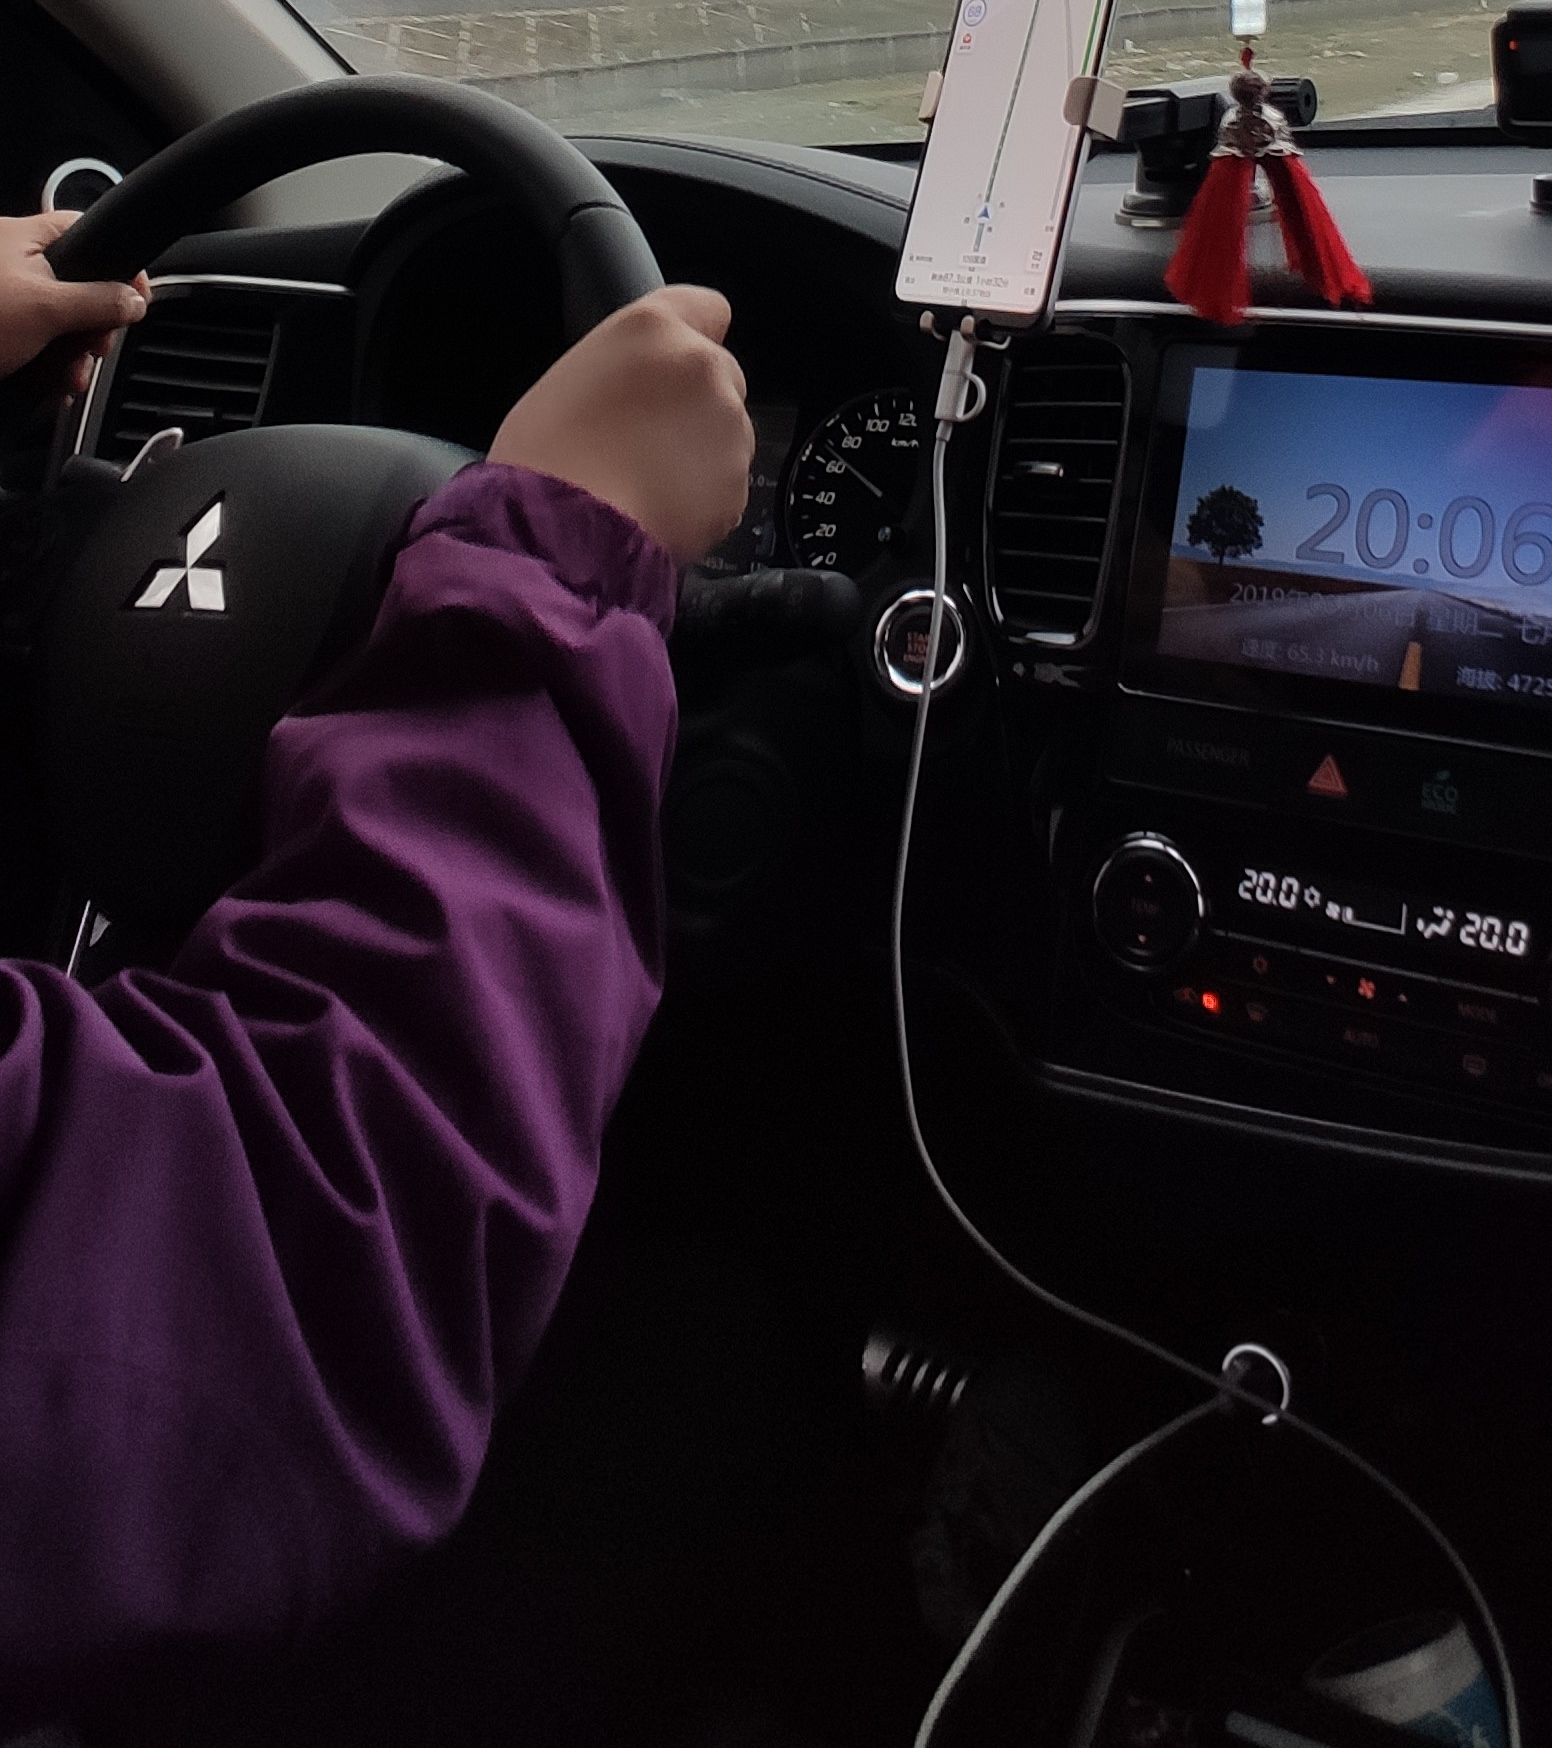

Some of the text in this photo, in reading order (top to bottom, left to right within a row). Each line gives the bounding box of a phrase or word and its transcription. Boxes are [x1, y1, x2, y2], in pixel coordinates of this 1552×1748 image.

[865, 418, 890, 433] 100
[841, 435, 862, 450] 80
[825, 460, 847, 475] 60
[815, 491, 836, 506] 40
[815, 523, 837, 539] 20
[825, 551, 837, 566] 0
[1330, 646, 1380, 675] km/h
[1166, 736, 1251, 768] PASSENGER
[1421, 782, 1459, 803] ECO
[1235, 867, 1302, 911] 20.0
[1458, 909, 1534, 958] 20.0
